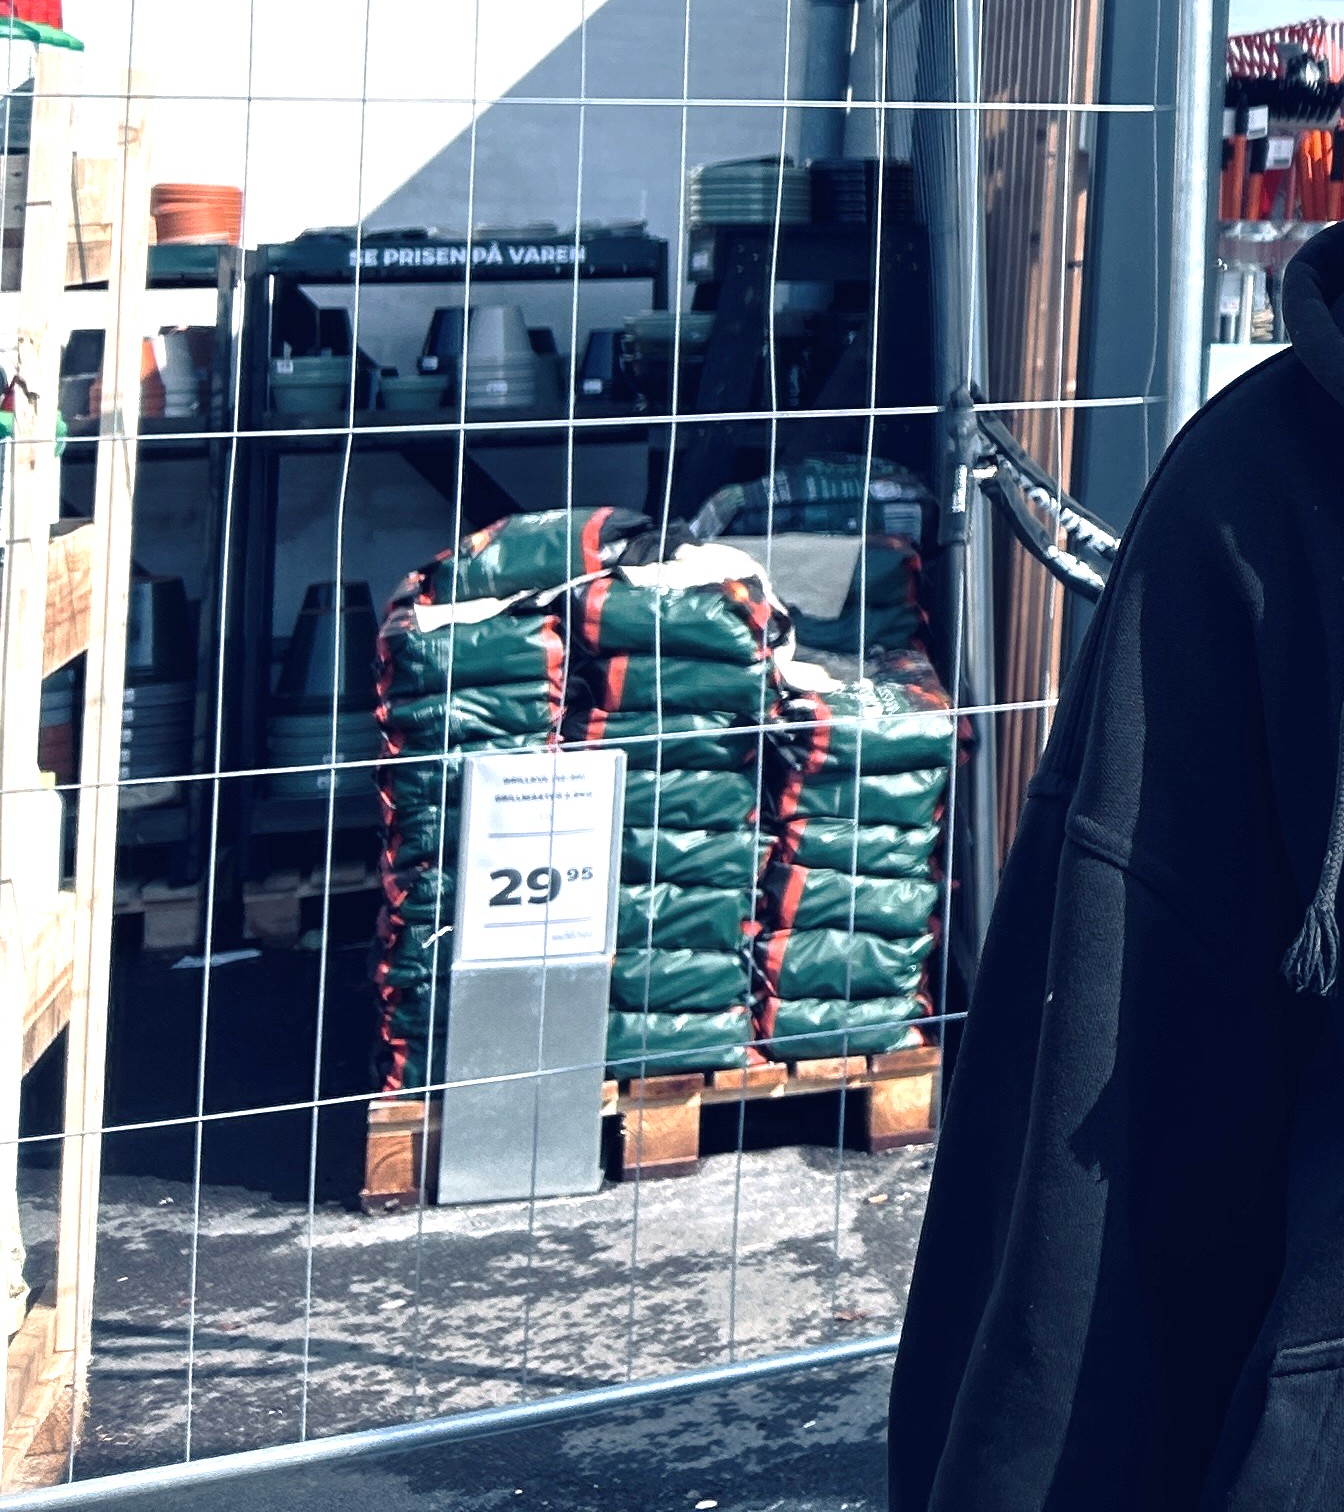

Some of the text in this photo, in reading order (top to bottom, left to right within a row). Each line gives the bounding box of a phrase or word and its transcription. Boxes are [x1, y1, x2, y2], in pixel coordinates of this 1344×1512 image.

[349, 241, 586, 267] SE PRISEN PÅ VAREN
[488, 866, 594, 908] 29 95
